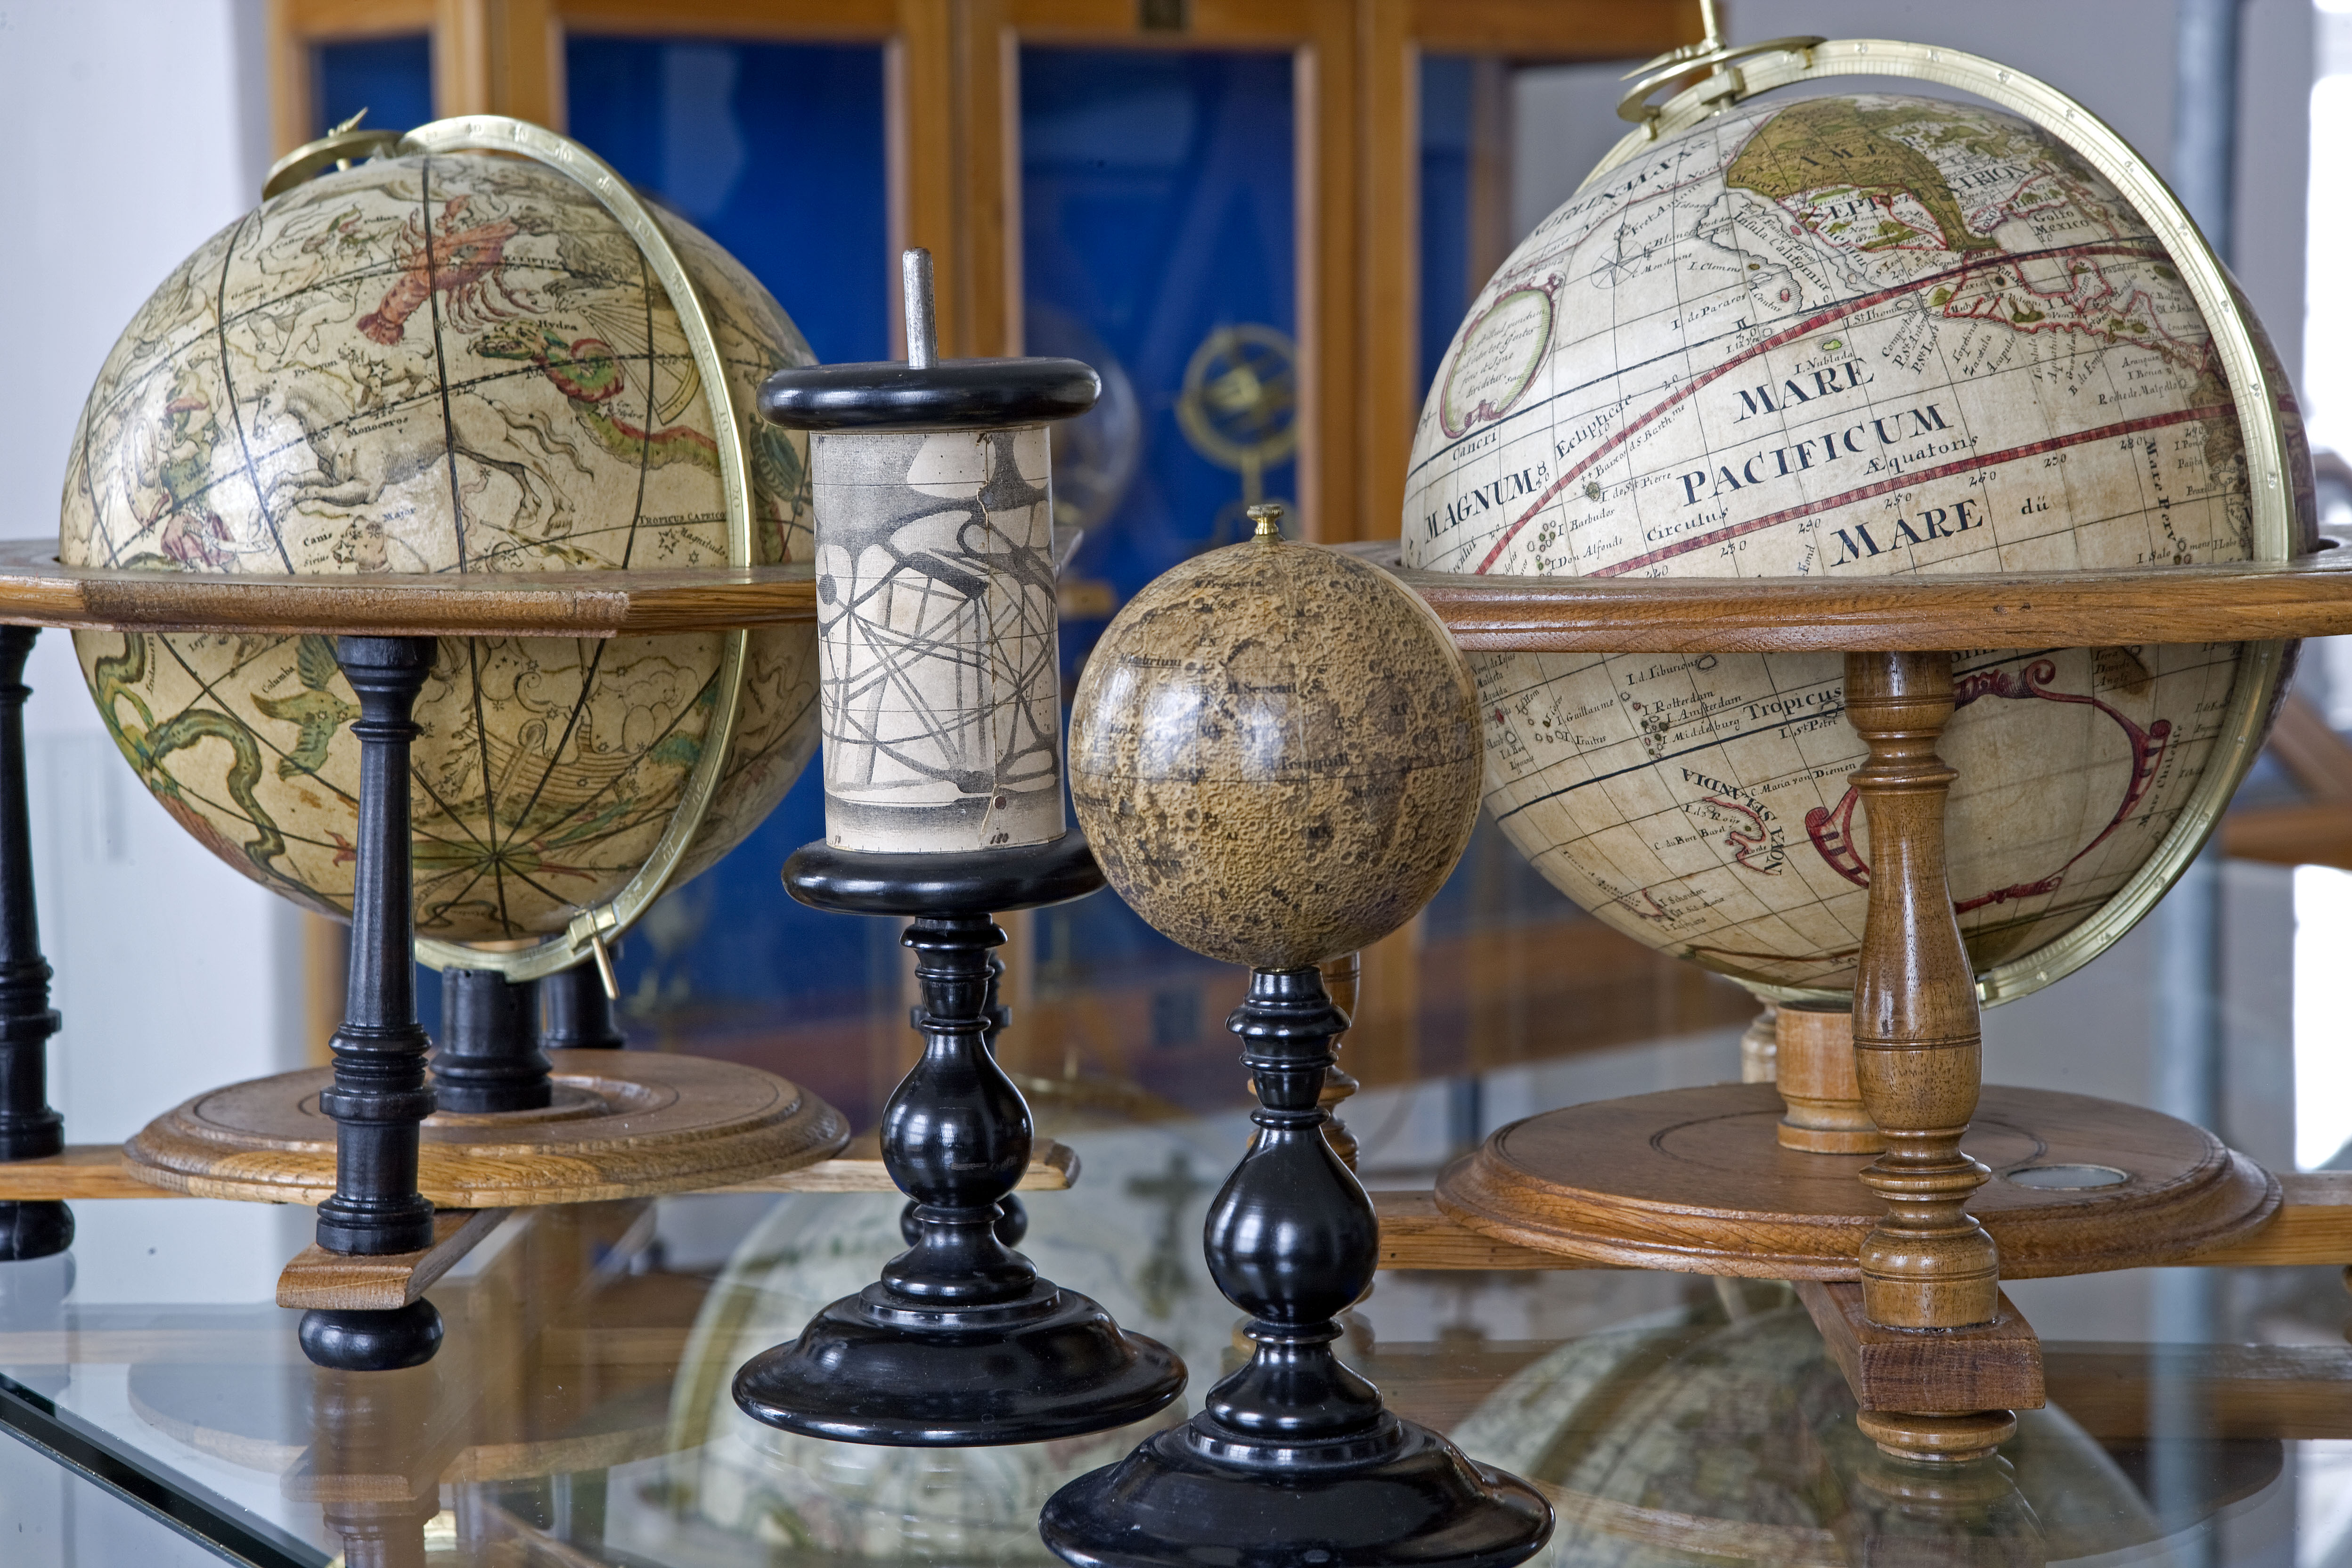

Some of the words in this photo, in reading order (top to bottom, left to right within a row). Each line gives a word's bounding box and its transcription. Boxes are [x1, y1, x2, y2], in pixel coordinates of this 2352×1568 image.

[1732, 357, 1875, 424] MARE
[1676, 403, 1954, 507] PACIFICUM
[1968, 471, 1997, 487] 260
[2145, 437, 2163, 492] Mare
[1425, 467, 1537, 544] MAGNUM
[1829, 498, 1984, 567] MARE
[1743, 686, 1842, 721] Tropicus
